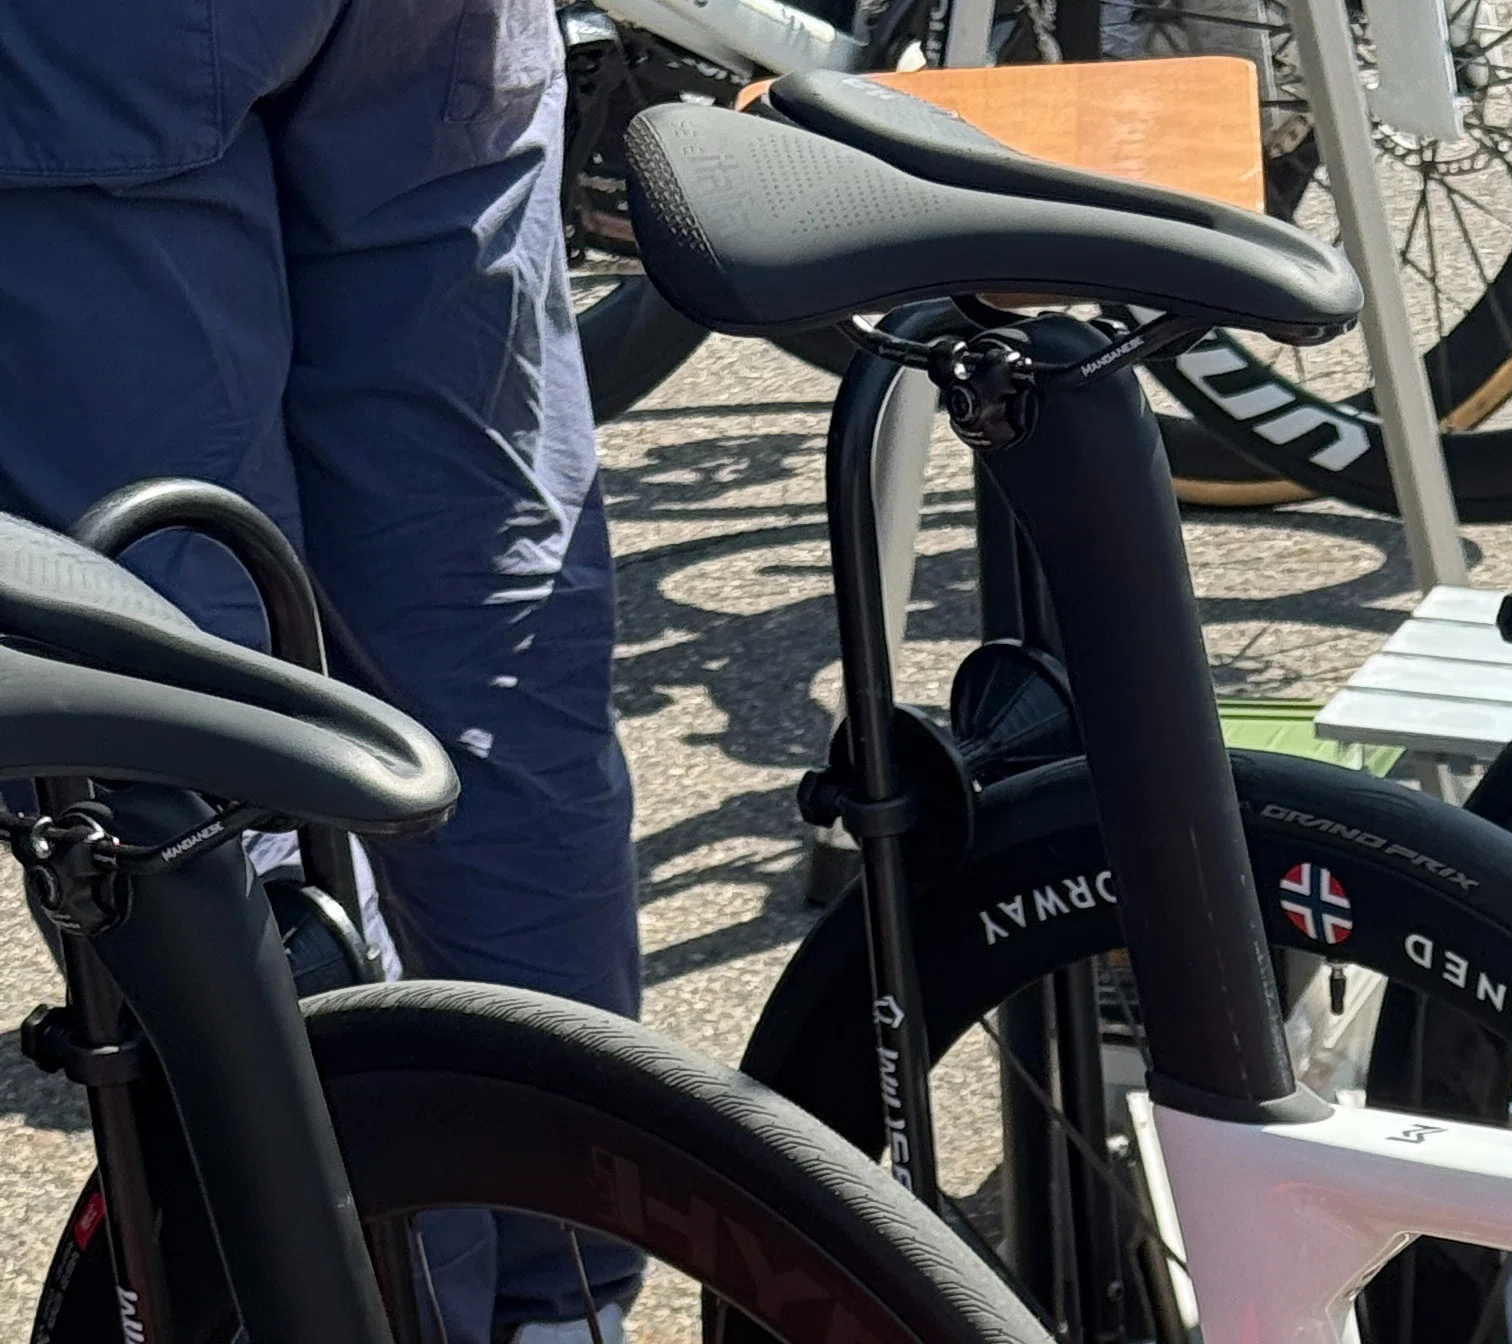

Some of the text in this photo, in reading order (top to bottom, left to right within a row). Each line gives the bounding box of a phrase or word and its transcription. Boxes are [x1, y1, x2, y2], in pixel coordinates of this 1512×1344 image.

[1260, 803, 1481, 891] GRAND PRIX
[978, 870, 1119, 946] ORWAY
